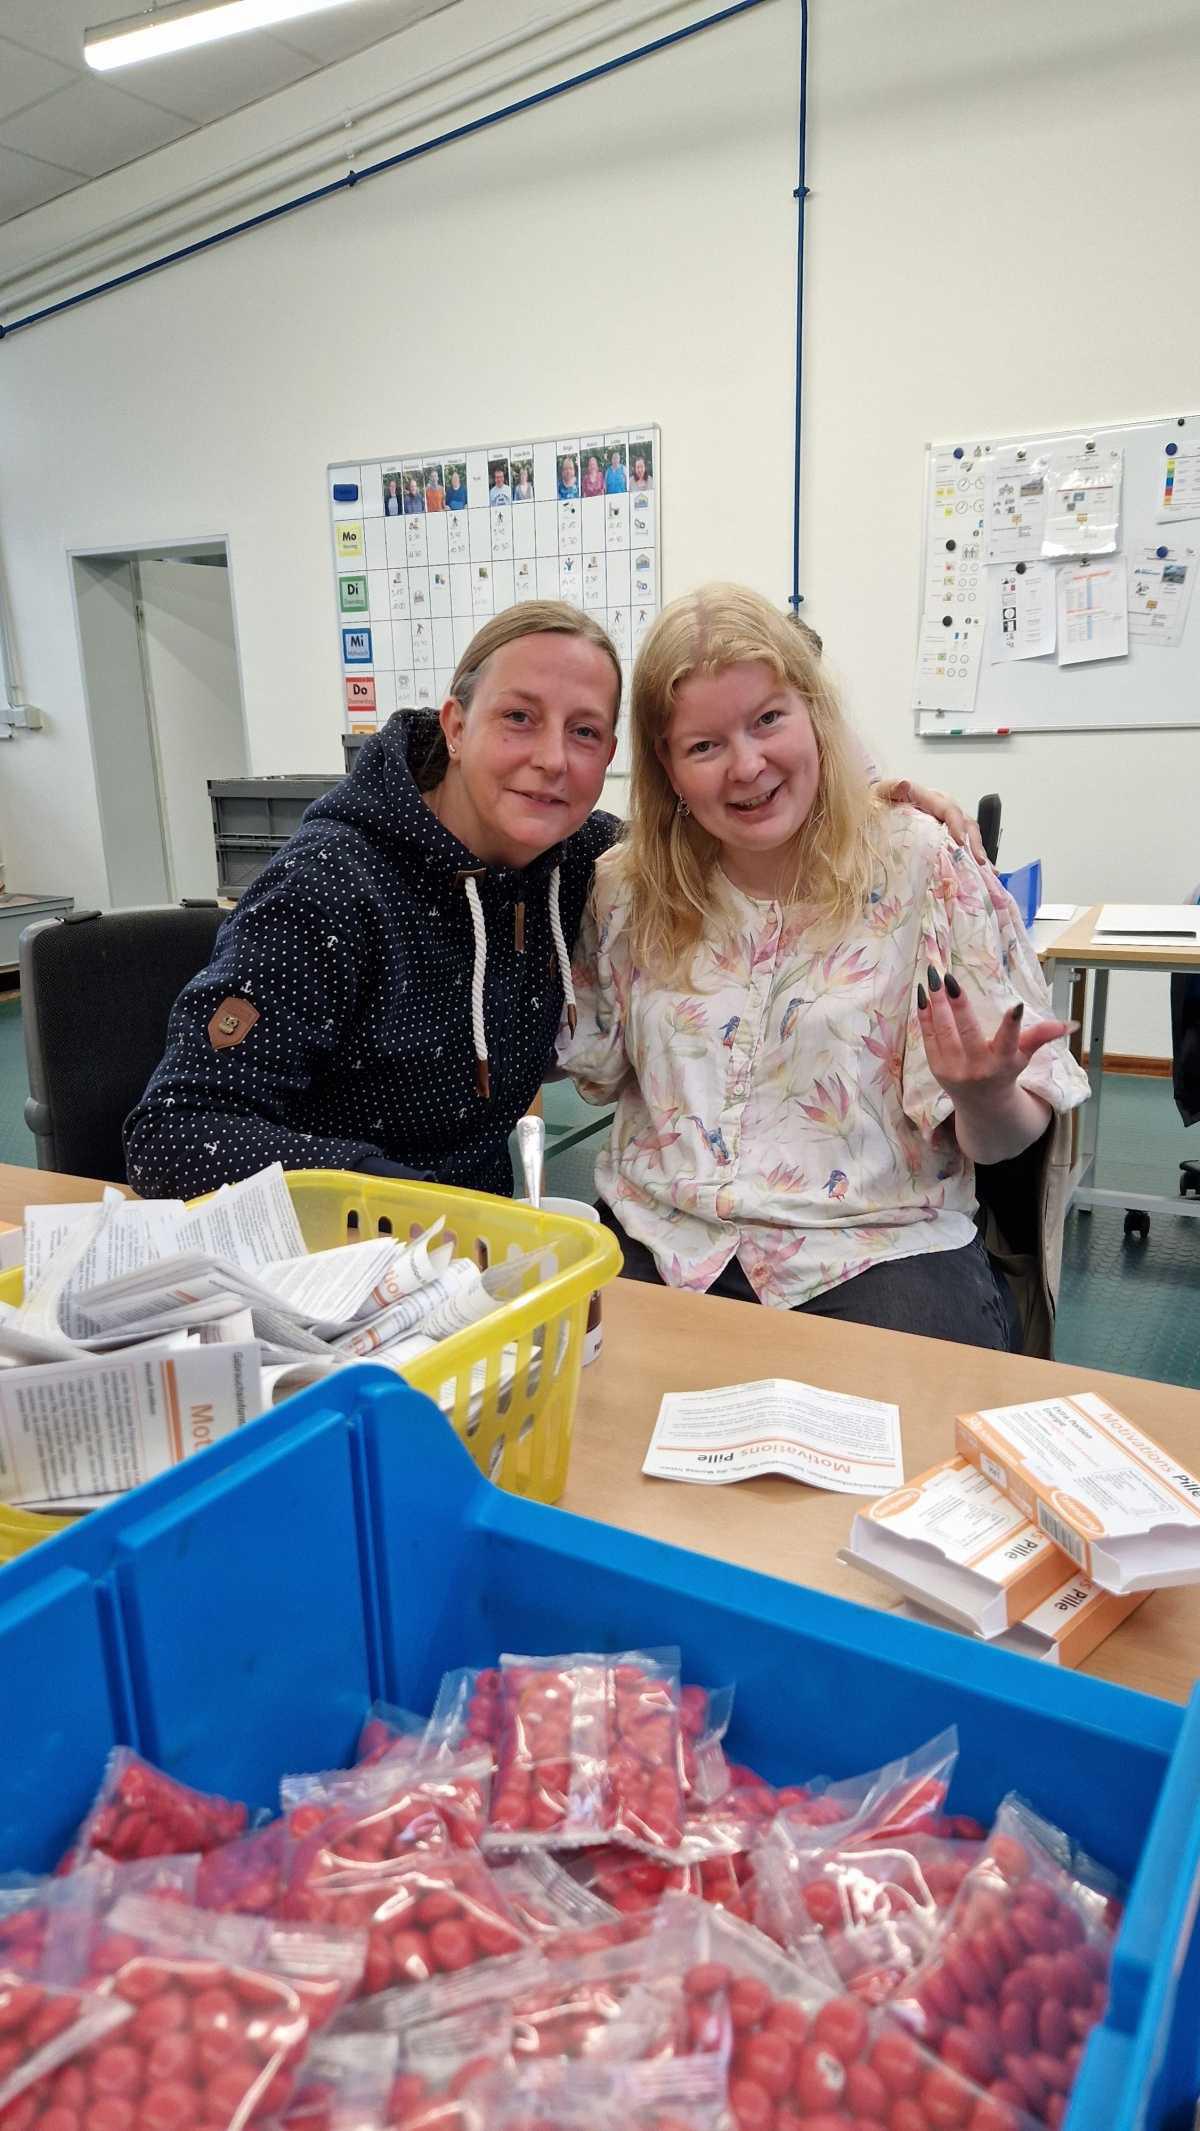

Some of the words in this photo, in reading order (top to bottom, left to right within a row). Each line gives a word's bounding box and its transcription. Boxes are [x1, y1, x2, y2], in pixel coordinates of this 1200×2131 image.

[343, 531, 357, 541] Mo
[347, 583, 359, 595] Di
[350, 634, 364, 647] Mi
[353, 684, 368, 695] Do
[191, 1403, 215, 1451] Mot
[697, 1452, 735, 1462] Pille
[741, 1444, 851, 1475] Motivations
[1171, 1474, 1200, 1497] Pille
[1004, 1539, 1038, 1559] Pille
[1054, 1588, 1089, 1611] Pille
